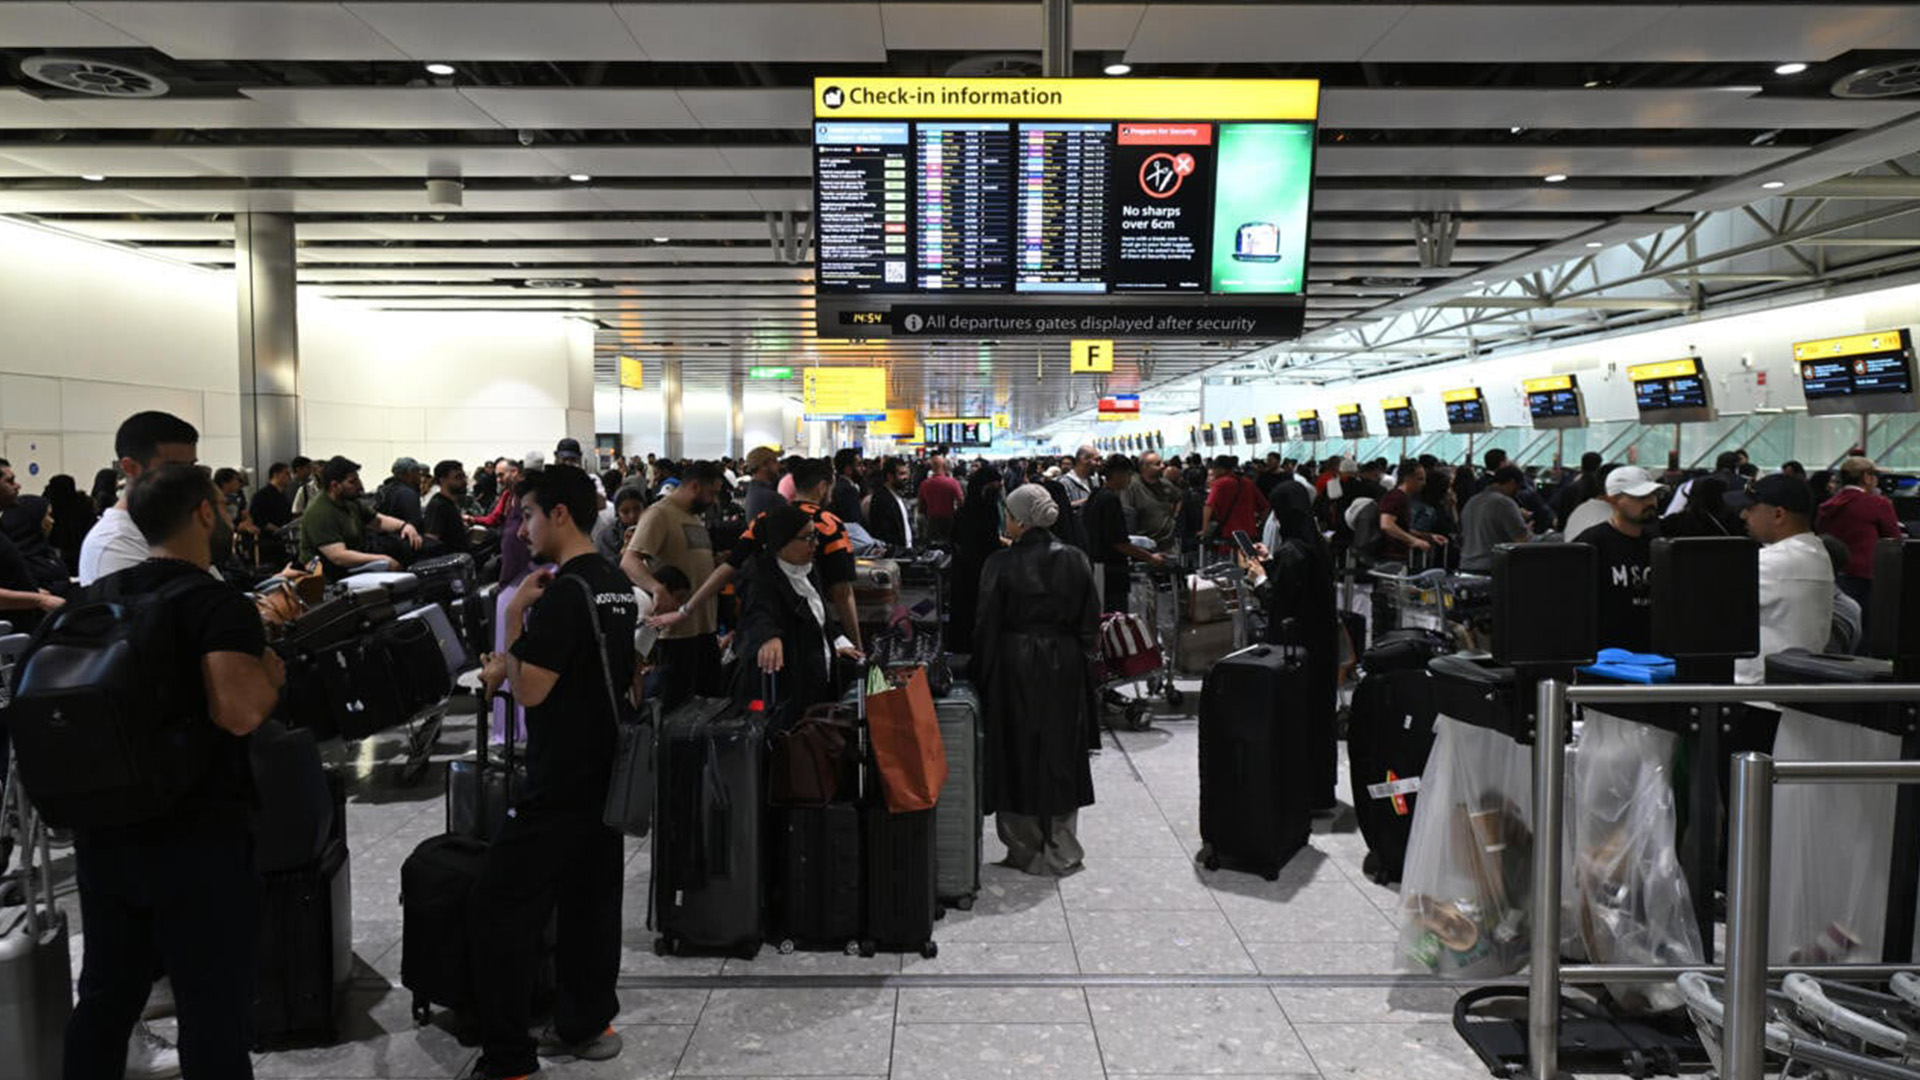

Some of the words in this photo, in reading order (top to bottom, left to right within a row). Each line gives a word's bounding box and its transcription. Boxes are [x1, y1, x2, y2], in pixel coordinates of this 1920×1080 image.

[849, 86, 935, 105] Check-in
[941, 86, 1062, 105] information
[1122, 205, 1140, 217] No
[1142, 205, 1181, 219] sharps
[1121, 220, 1148, 230] over
[1151, 218, 1175, 230] 6cm
[853, 313, 882, 324] 14:54
[925, 315, 945, 329] All
[949, 315, 1032, 332] departures
[1036, 317, 1077, 332] gates
[1080, 315, 1154, 332] displayed
[1157, 315, 1193, 330] after
[1197, 317, 1256, 332] security
[1088, 345, 1100, 367] F
